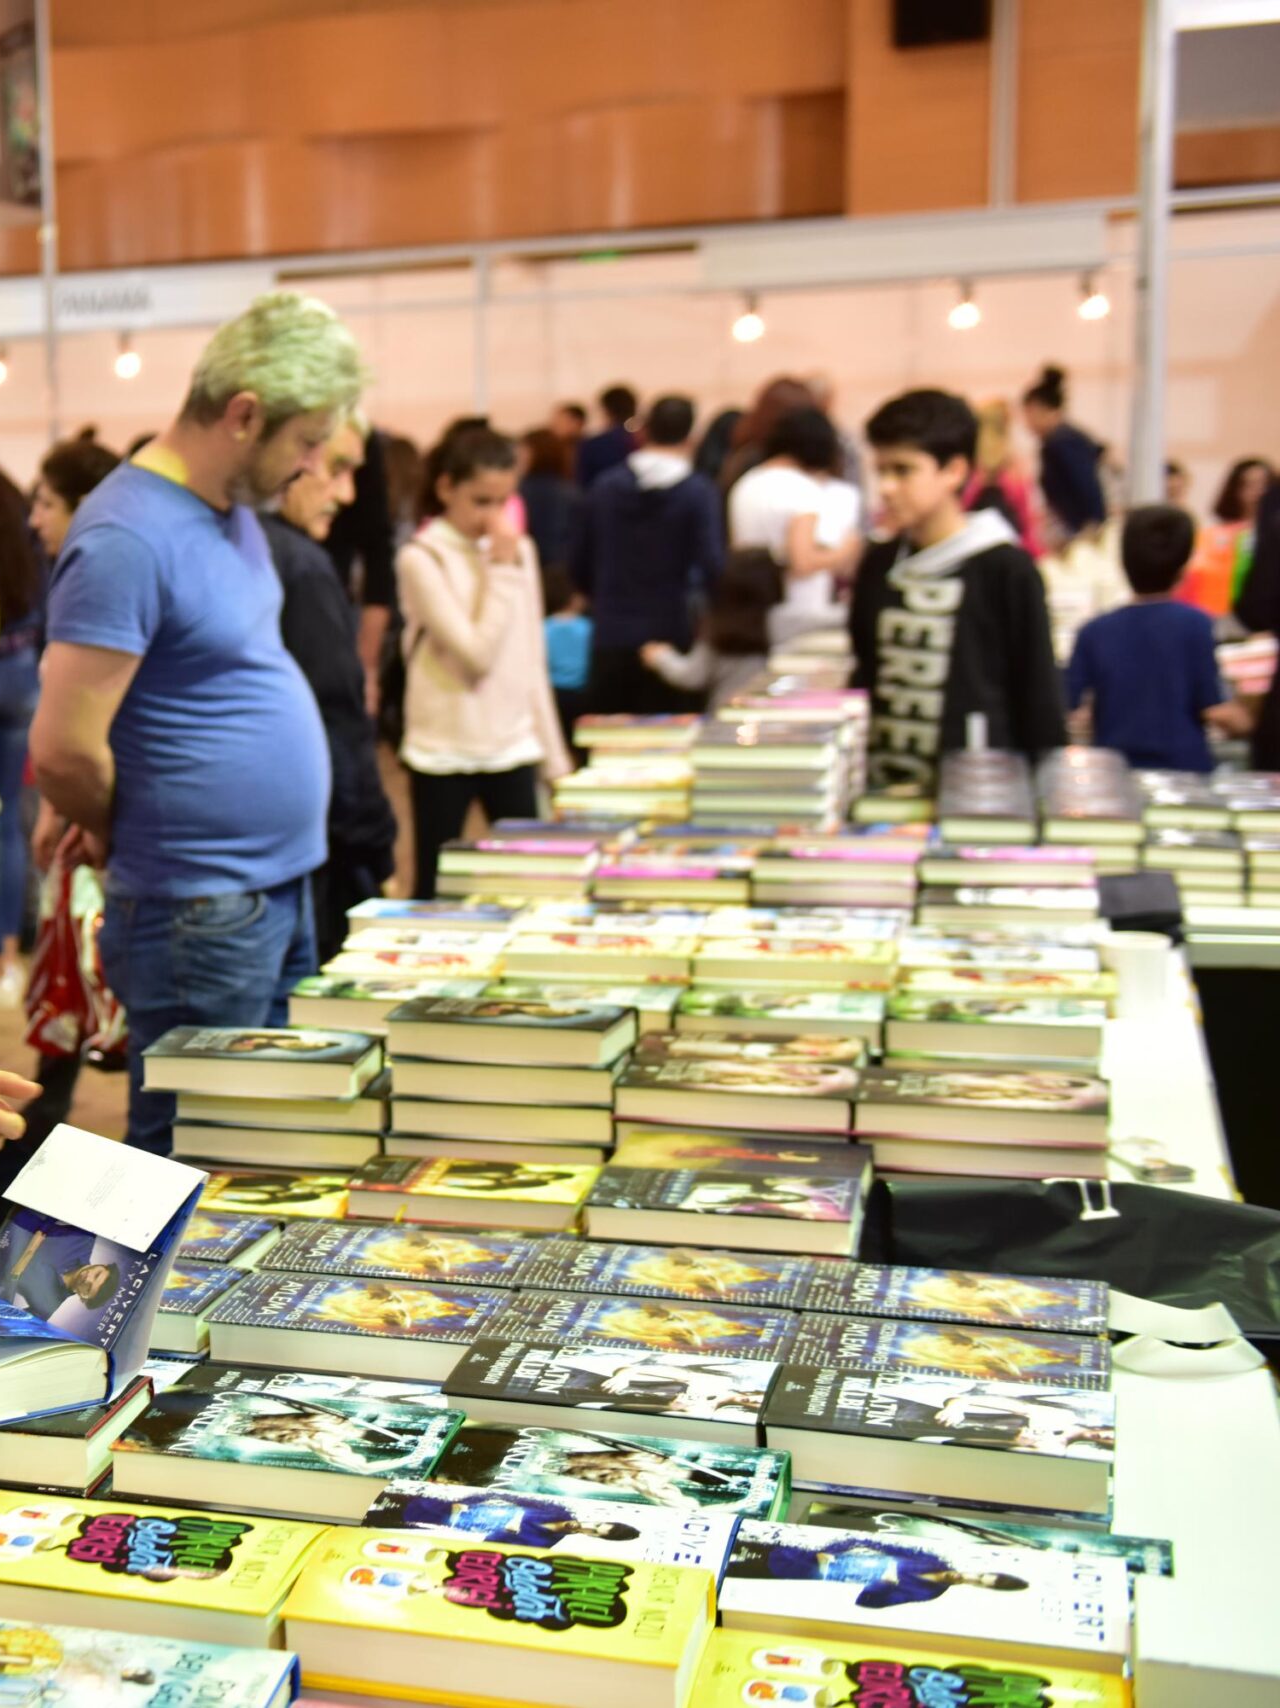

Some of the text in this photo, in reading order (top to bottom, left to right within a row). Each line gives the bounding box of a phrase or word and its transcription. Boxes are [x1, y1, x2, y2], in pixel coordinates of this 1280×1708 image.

[307, 1227, 350, 1258] AYLEMA
[570, 1246, 604, 1277] AYLEMA
[256, 1280, 305, 1316] AYLEMA
[852, 1267, 882, 1302] AYLEMA
[536, 1299, 577, 1333] AYLEMA
[836, 1322, 869, 1359] AYLEMA
